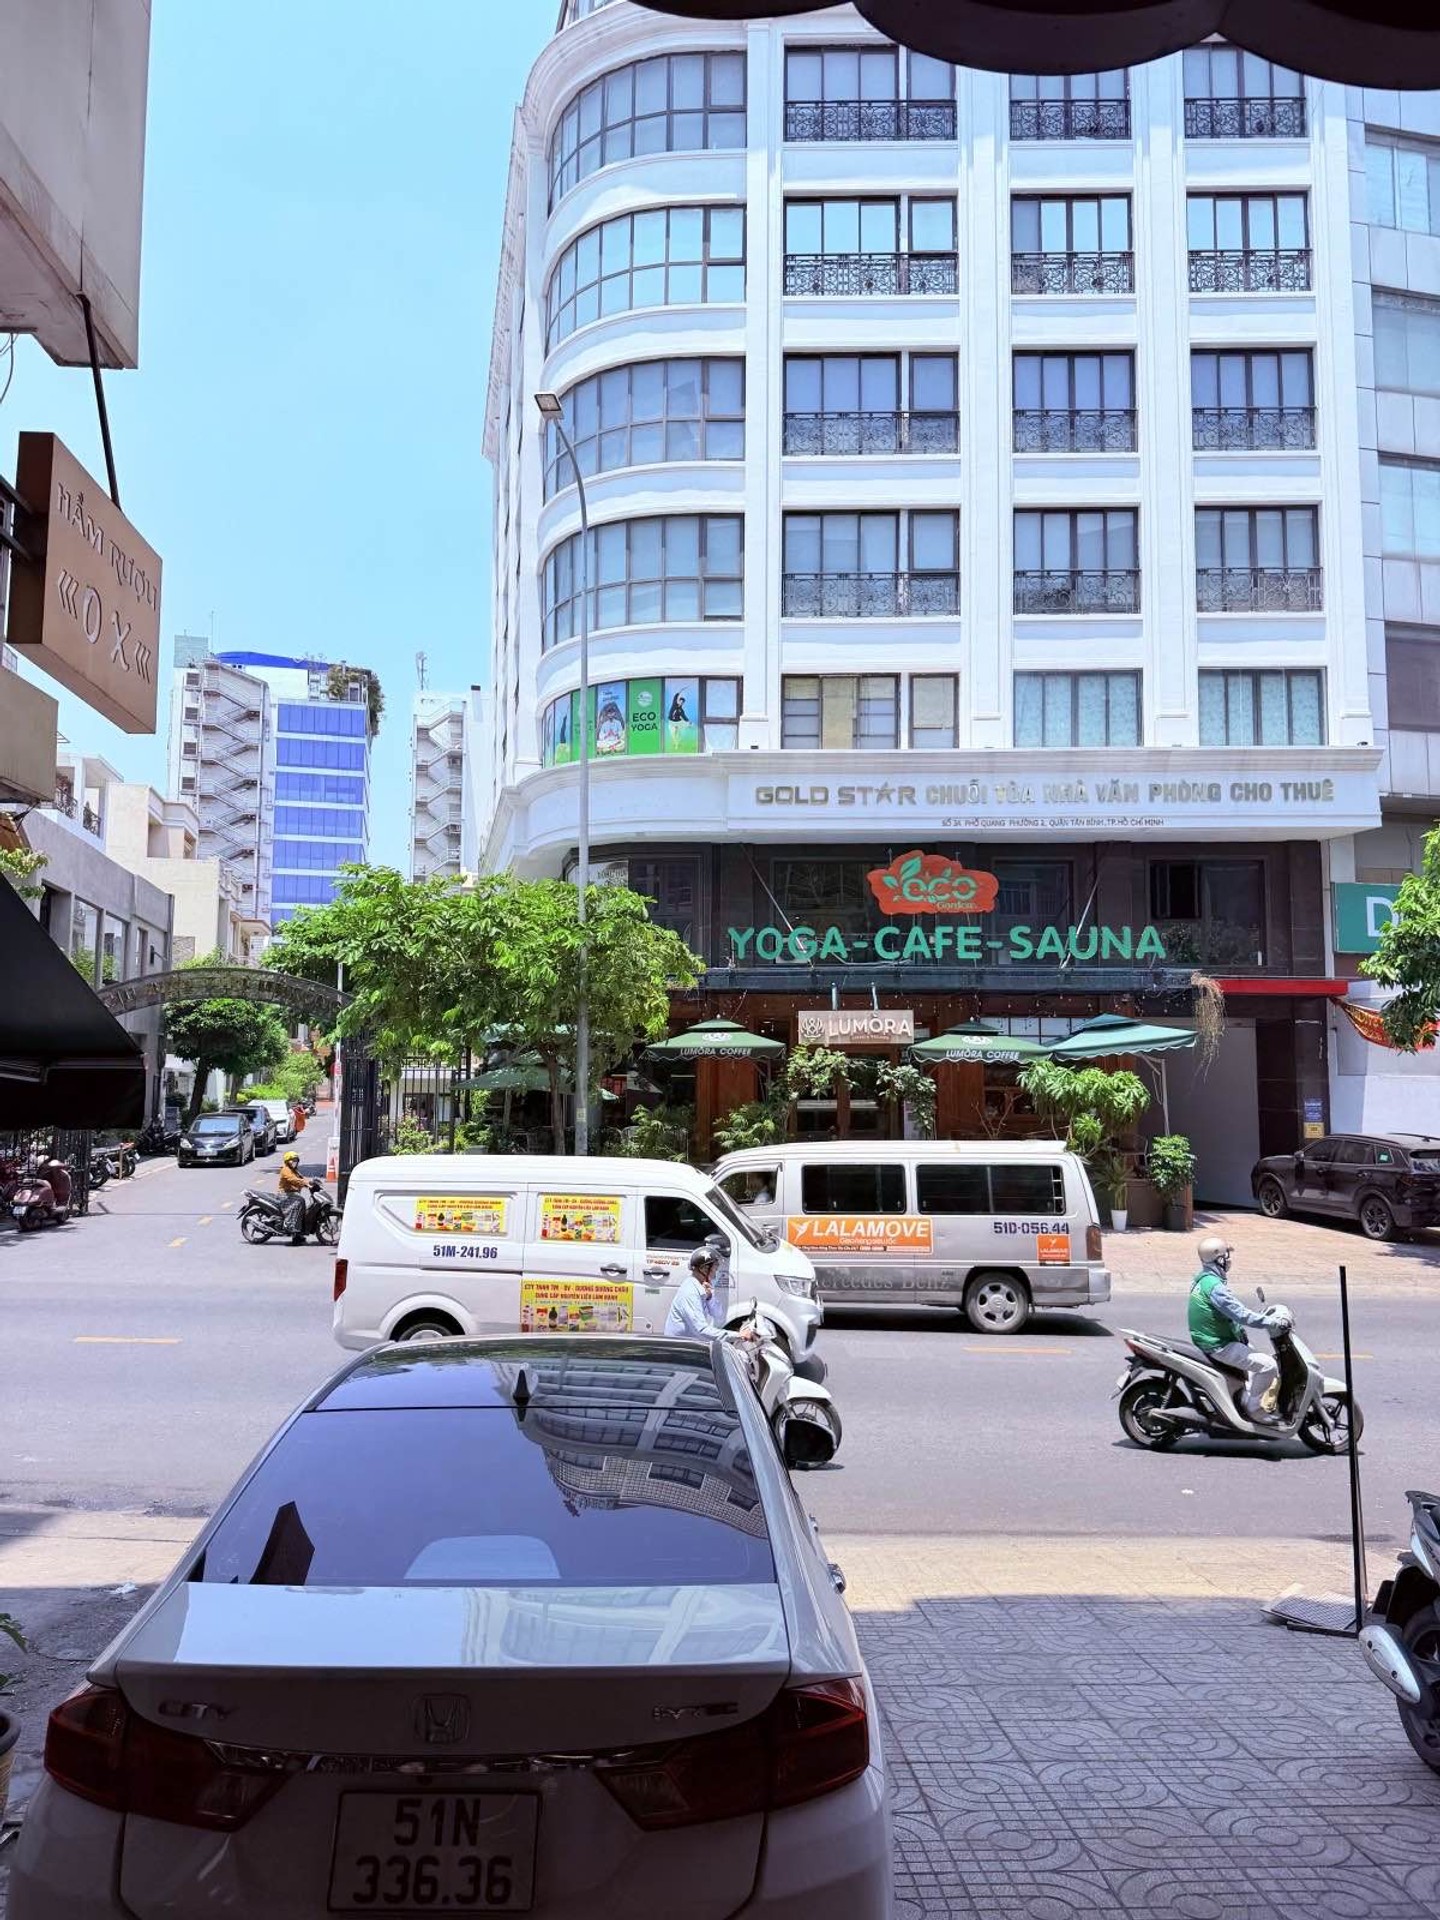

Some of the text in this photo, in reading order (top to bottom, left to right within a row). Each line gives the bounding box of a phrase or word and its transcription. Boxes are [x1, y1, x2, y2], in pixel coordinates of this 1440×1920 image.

[632, 712, 657, 722] ECO
[631, 722, 658, 731] YOGA
[755, 785, 829, 806] GOLD
[925, 779, 988, 805] CHUỖI
[1042, 779, 1089, 804] NHÀ
[1095, 779, 1139, 804] VĂN
[1148, 780, 1221, 803] PHÒNG
[1230, 782, 1273, 802] CHO
[1280, 778, 1334, 802] THUÊ
[980, 818, 1006, 828] QUANG
[728, 924, 1166, 961] YOGA-CAFE-SAUNA
[719, 1047, 752, 1056] COFFEE
[986, 1051, 1020, 1060] COFFEE
[812, 1220, 930, 1238] LALAMOVE
[993, 1221, 1070, 1235] 51D-056.44
[432, 1244, 499, 1259] 51M-241.96
[902, 1275, 950, 1289] Benz
[394, 1798, 482, 1847] 51N
[352, 1855, 513, 1905] 336.36
